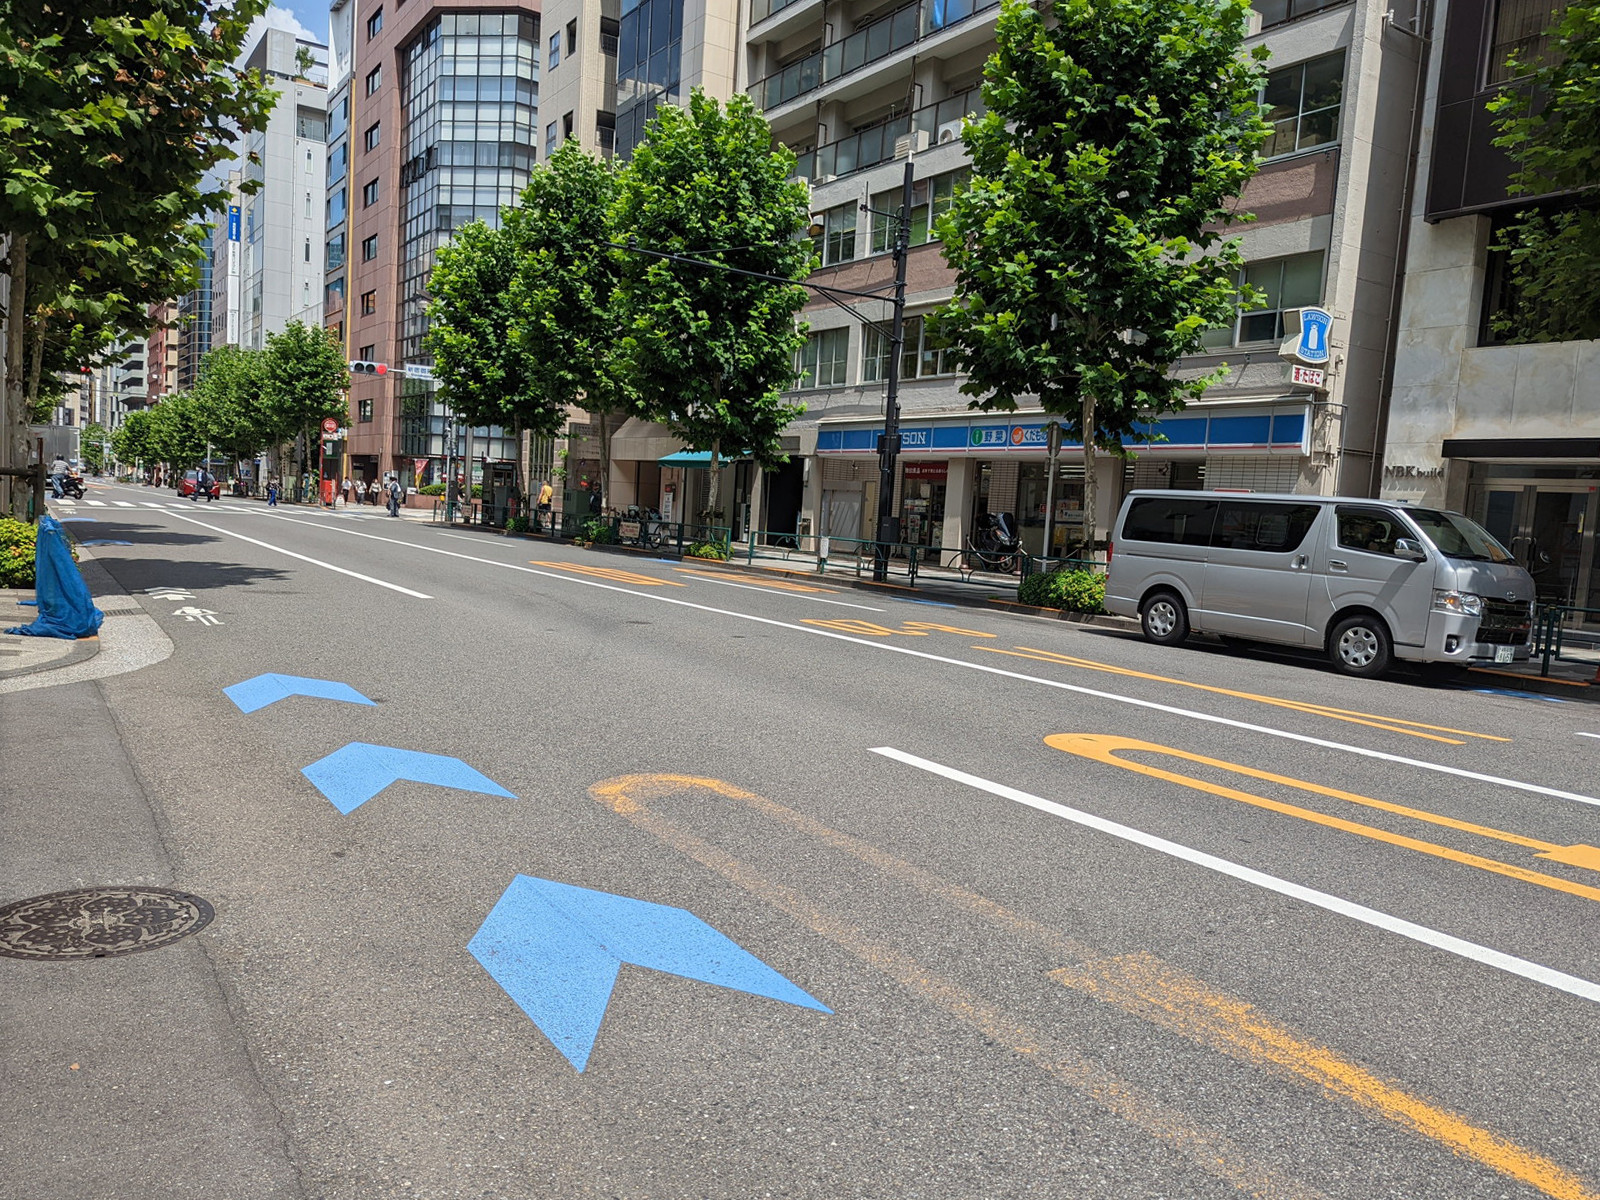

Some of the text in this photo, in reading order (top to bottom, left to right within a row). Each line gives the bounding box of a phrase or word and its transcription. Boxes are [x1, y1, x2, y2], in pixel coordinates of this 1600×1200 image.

[1303, 313, 1328, 325] LAWSON
[1300, 346, 1325, 358] STATION
[984, 430, 1004, 442] 野菜
